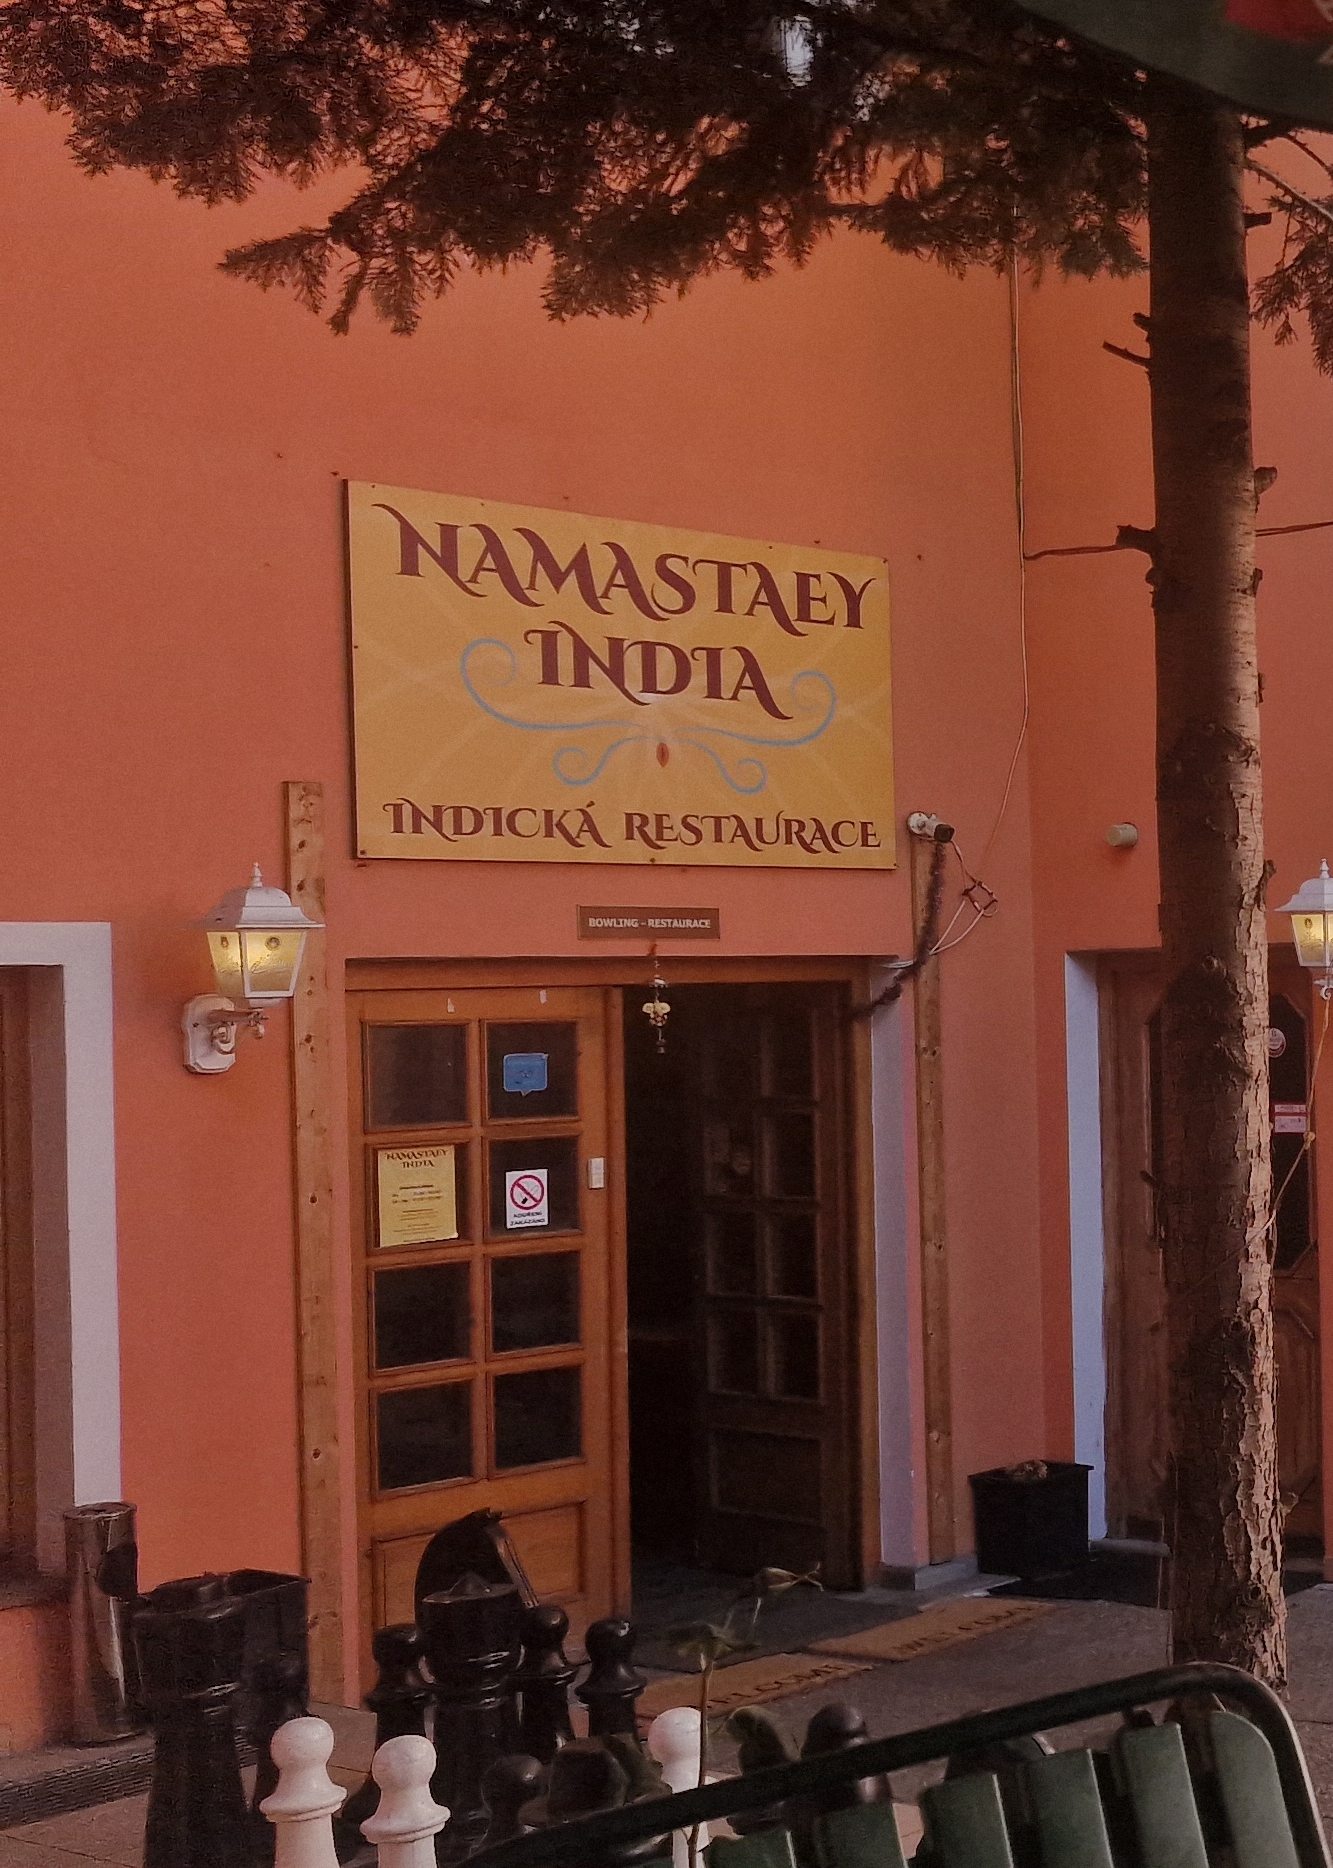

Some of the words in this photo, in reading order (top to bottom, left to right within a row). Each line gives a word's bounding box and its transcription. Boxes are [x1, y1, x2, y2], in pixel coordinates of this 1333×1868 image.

[371, 503, 877, 637] NAMASTAEY
[523, 620, 794, 721] INDIA
[383, 797, 613, 849] INDICKÁ
[623, 810, 882, 855] RESTAURACE
[588, 917, 639, 928] BOWLING
[648, 918, 711, 929] RESTAURACE
[401, 1160, 434, 1169] INDIA
